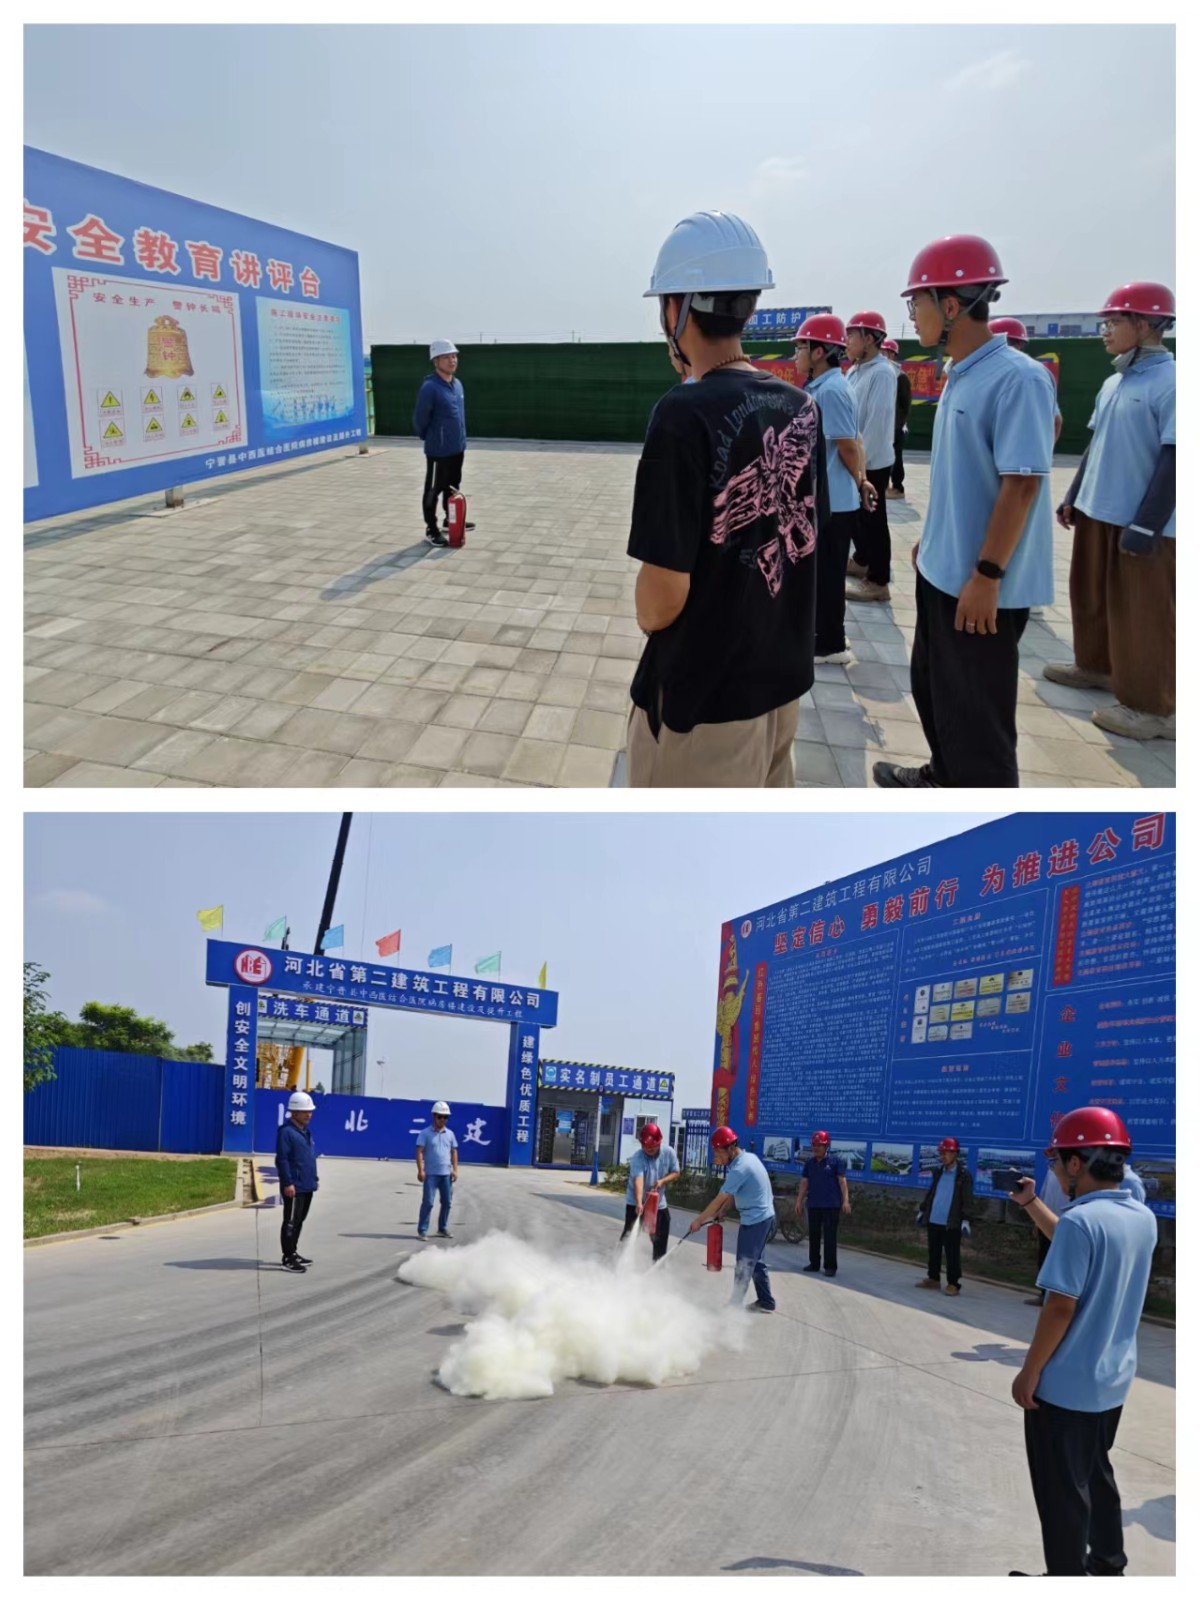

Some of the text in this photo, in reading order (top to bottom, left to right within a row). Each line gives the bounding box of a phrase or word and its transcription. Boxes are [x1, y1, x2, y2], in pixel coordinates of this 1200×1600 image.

[23, 199, 321, 300] 安全教育讲评台
[93, 292, 155, 307] 安全生产
[756, 855, 932, 932] 河北省第二建筑工程有限公司
[979, 812, 1166, 897] 为推进公司
[773, 877, 959, 956] 坚定信心 勇毅前行
[273, 1001, 350, 1024] 洗车通道
[284, 956, 541, 1009] 河北省第二建筑工程有限公司
[230, 1001, 251, 1125] 创安全文明环境
[516, 1035, 535, 1143] 建绿色优质工程
[560, 1068, 656, 1092] 实名制员工通道
